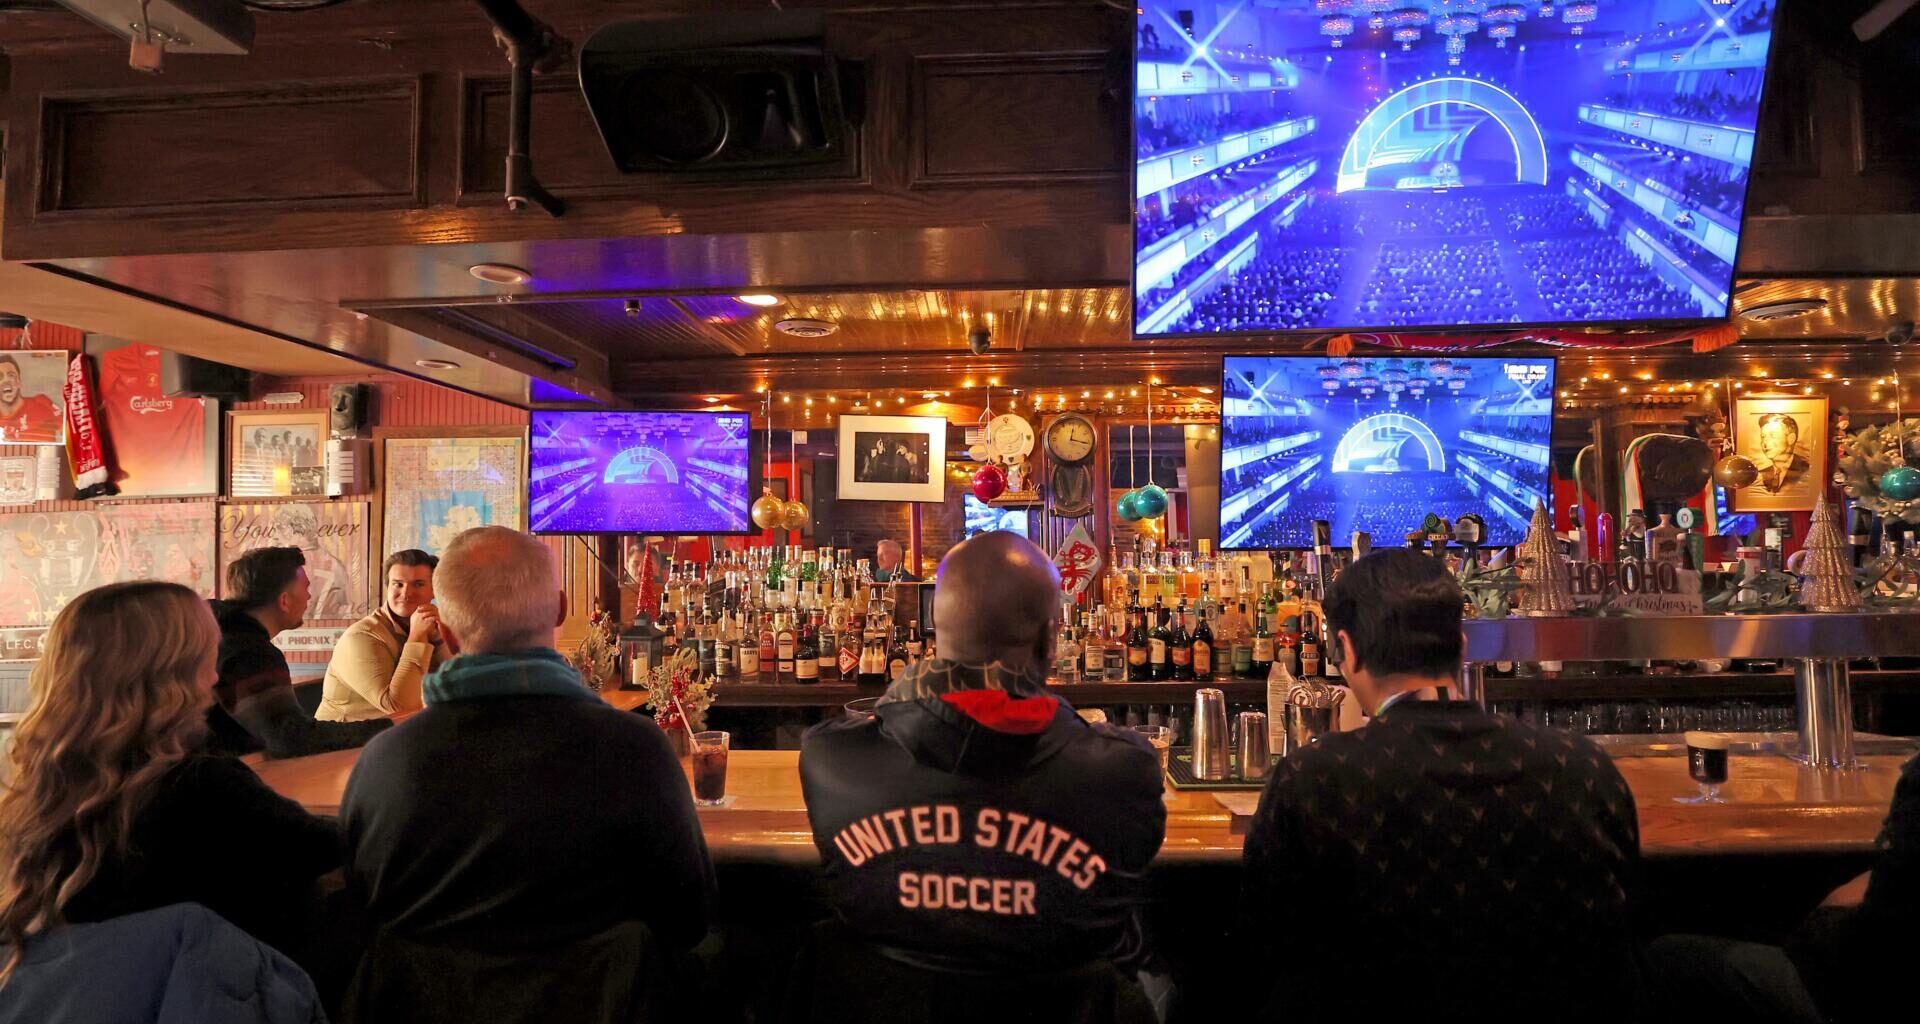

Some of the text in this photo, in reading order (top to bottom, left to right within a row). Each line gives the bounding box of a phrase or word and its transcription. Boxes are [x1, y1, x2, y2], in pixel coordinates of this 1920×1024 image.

[129, 395, 173, 414] Carlsberg
[288, 635, 330, 646] PHOENIX
[833, 804, 1107, 891] UNITED STATES
[899, 872, 1037, 916] SOCCER
